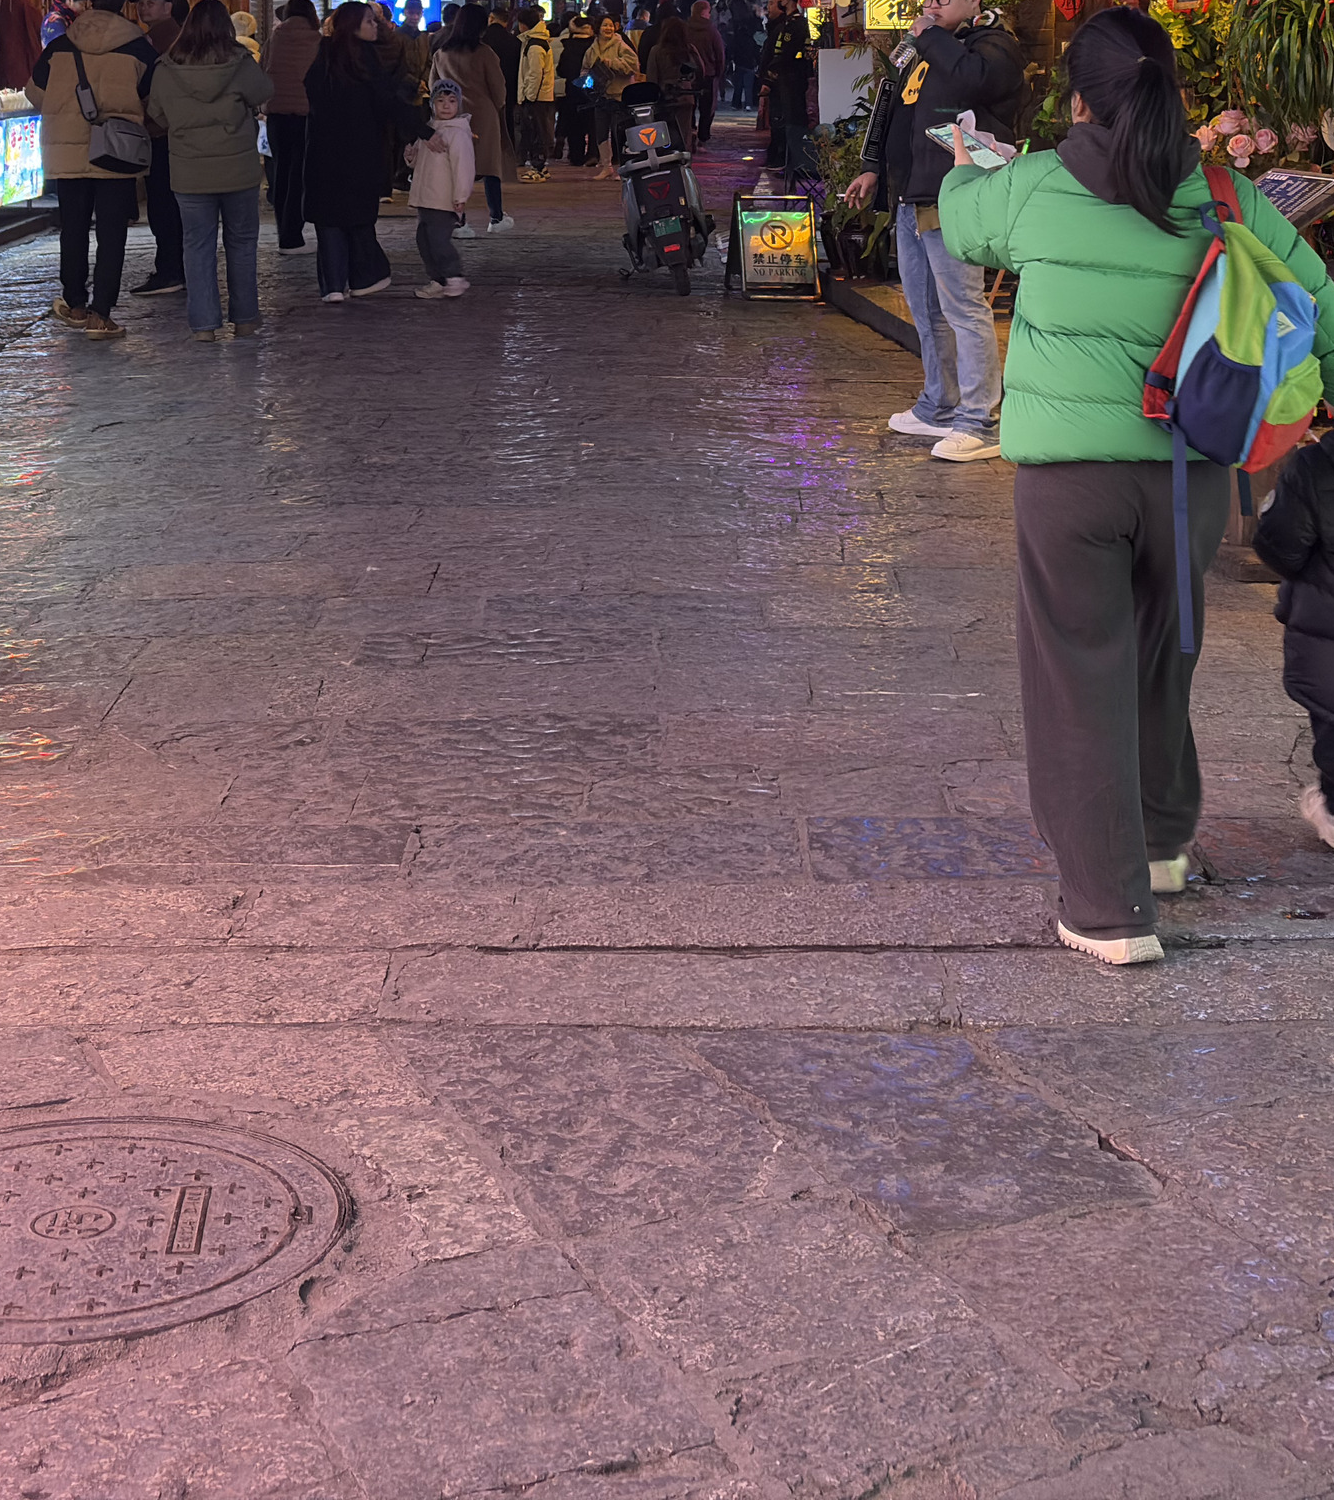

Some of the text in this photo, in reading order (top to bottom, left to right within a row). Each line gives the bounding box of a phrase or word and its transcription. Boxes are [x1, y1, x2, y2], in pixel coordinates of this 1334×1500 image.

[753, 253, 806, 265] 禁止停车
[754, 268, 806, 276] NO PARKING
